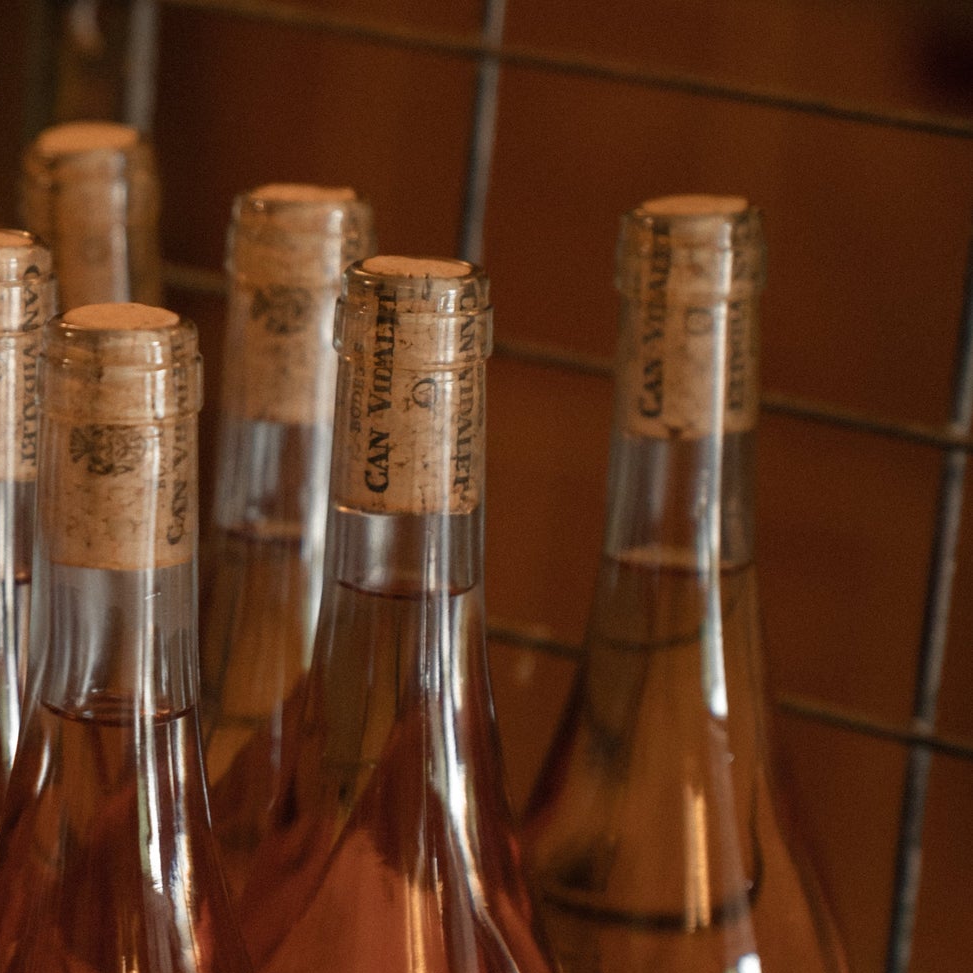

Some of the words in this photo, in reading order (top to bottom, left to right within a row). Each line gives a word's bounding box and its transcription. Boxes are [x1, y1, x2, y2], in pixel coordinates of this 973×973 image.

[367, 284, 398, 418] VIDALET
[365, 427, 391, 494] CAN
[453, 360, 475, 492] VIDALET
